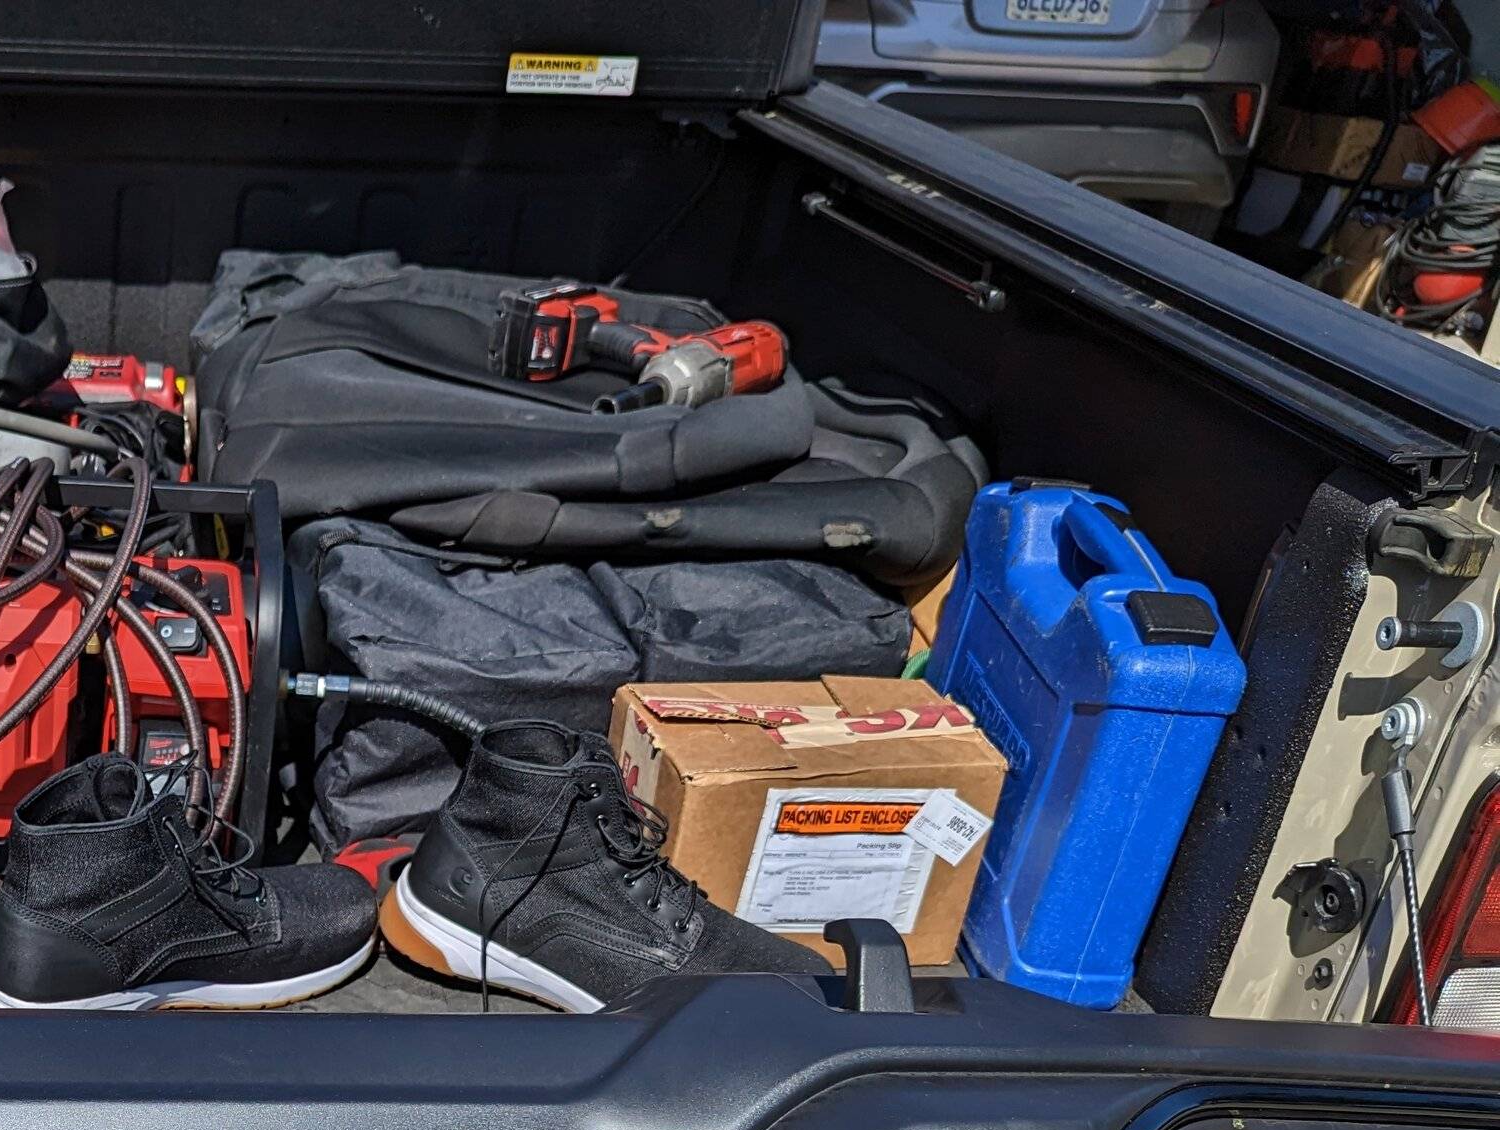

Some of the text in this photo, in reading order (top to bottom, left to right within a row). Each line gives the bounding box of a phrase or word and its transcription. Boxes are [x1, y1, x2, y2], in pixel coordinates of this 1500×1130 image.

[525, 60, 582, 71] WARNING
[781, 810, 832, 825] PACKING
[834, 810, 861, 825] LIST
[861, 810, 916, 825] ENCLOSE
